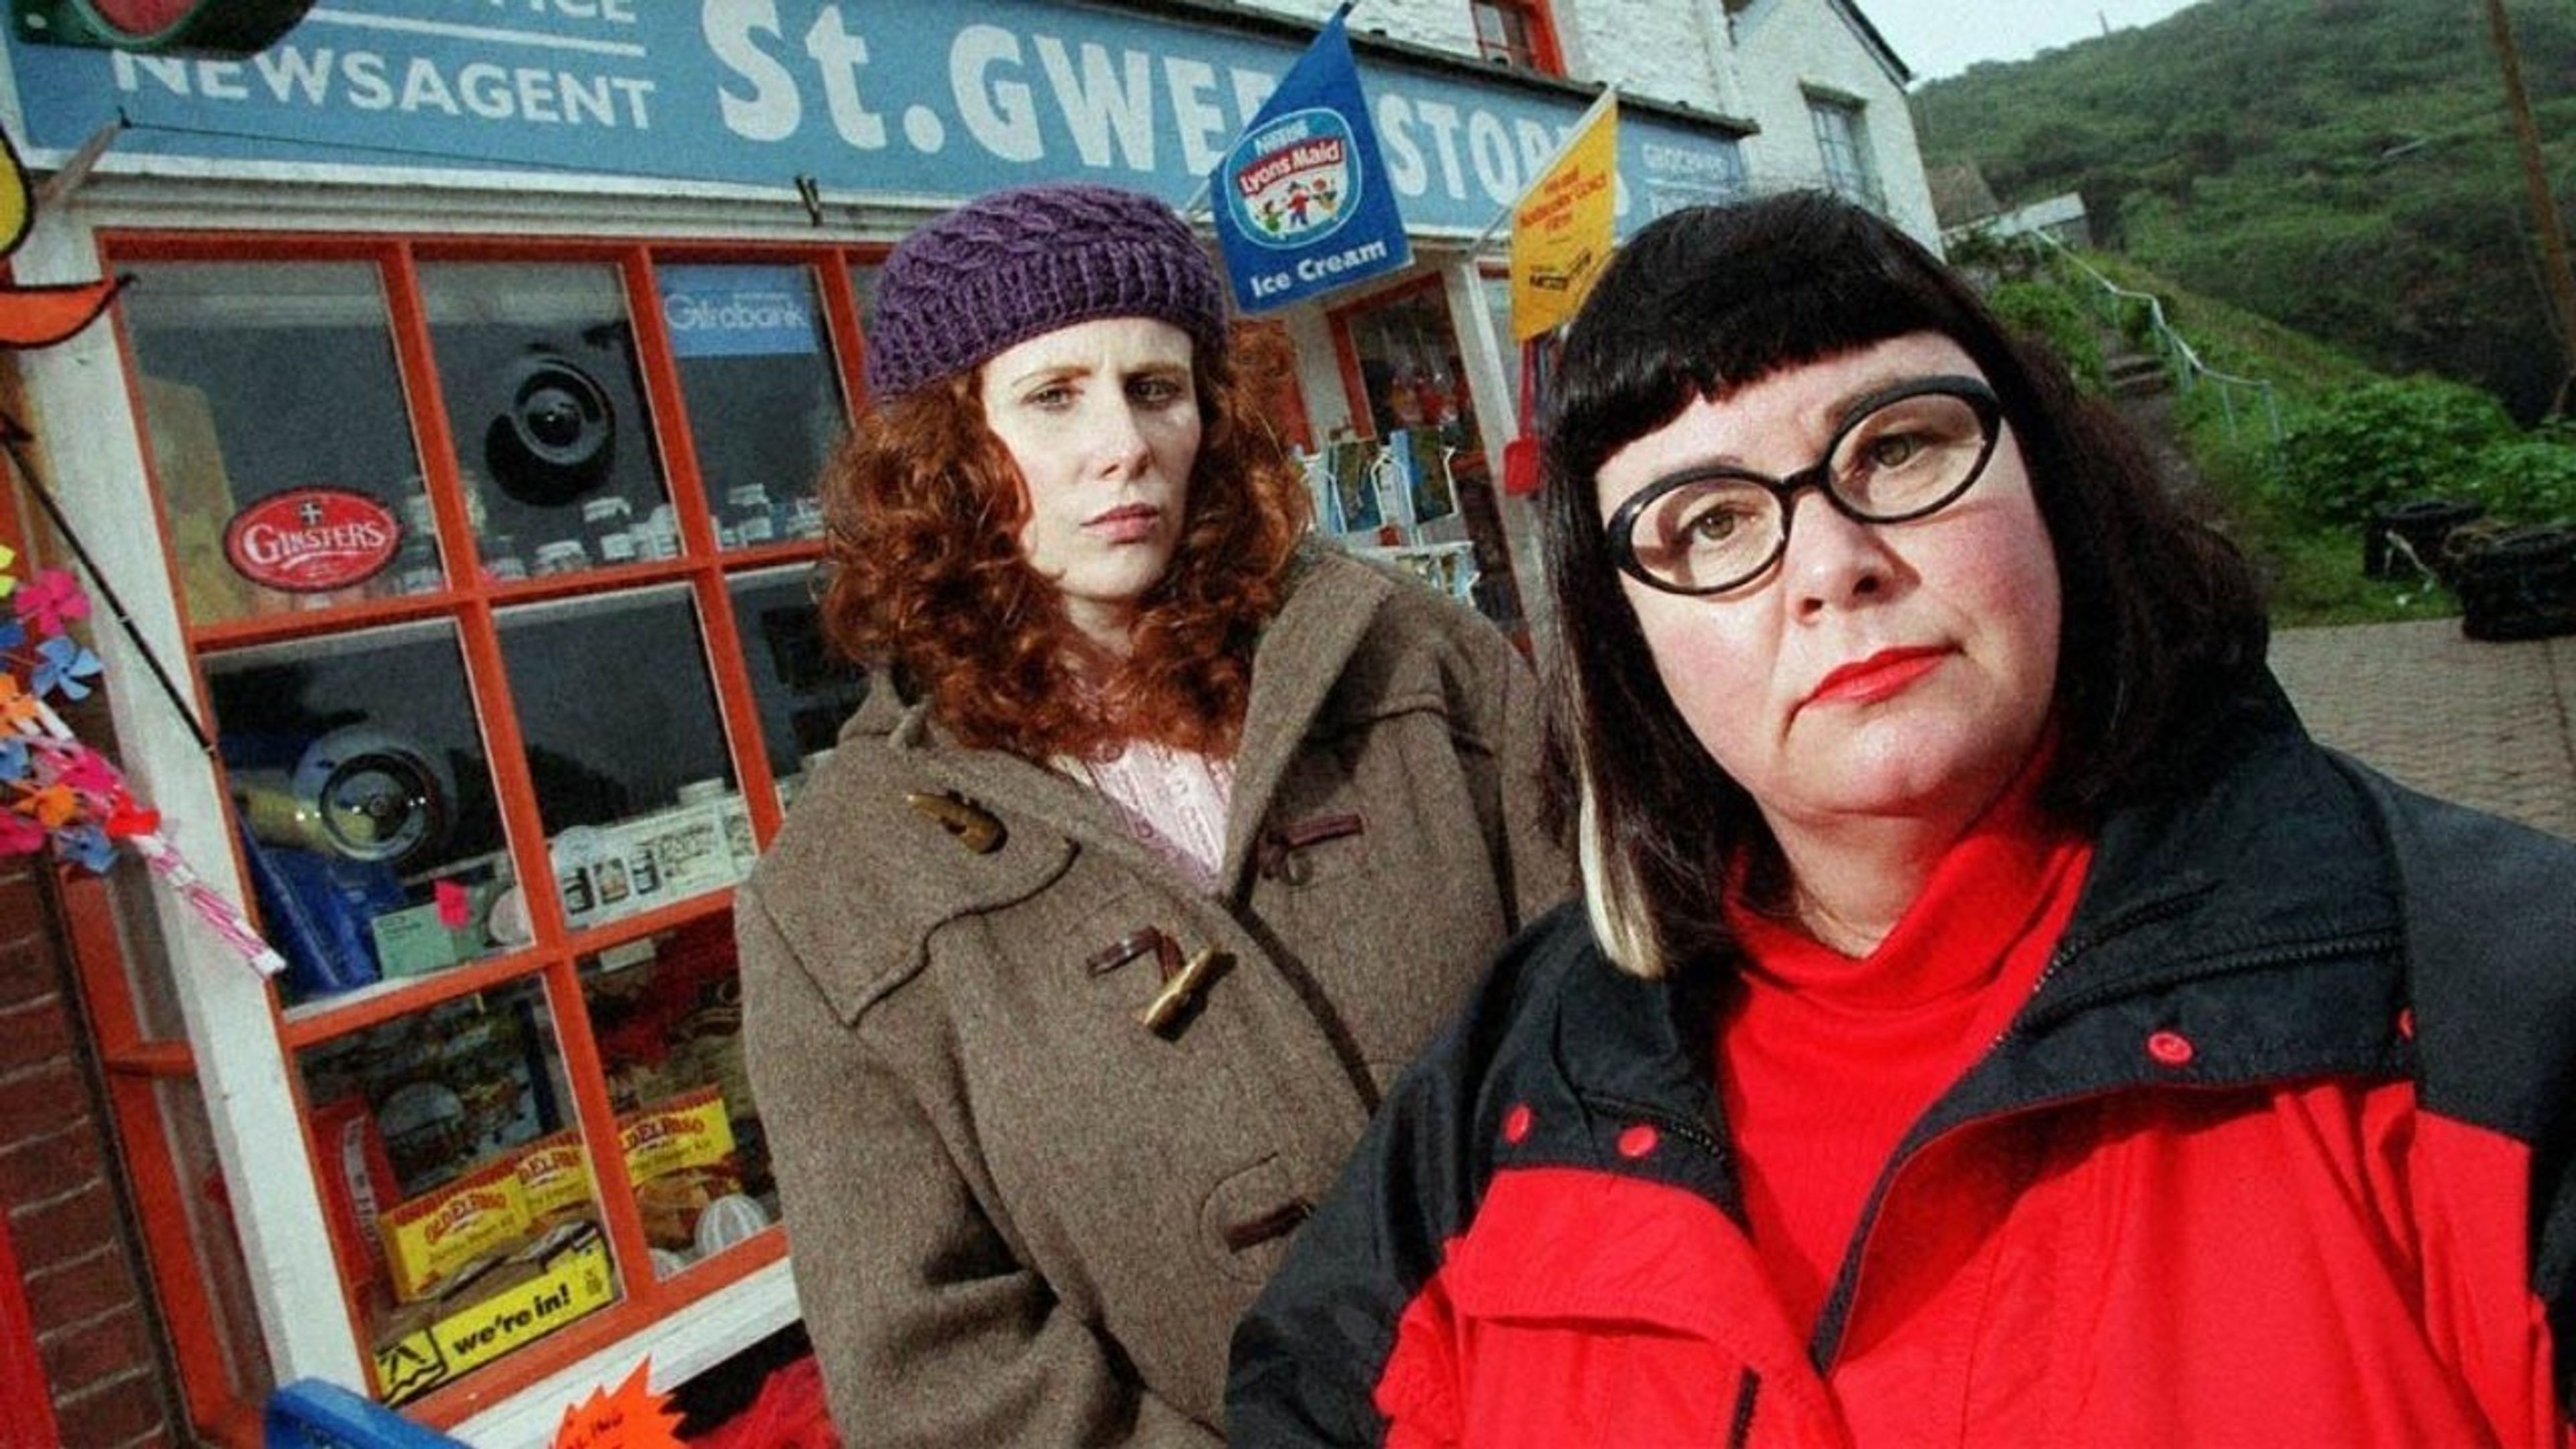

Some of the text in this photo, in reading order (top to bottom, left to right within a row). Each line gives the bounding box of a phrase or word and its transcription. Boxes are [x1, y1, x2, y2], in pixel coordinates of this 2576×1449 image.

[111, 45, 655, 129] NEWSAGENT
[1240, 139, 1340, 195] Lyons Maid
[1250, 240, 1387, 298] Ice Cream
[453, 1283, 572, 1355] we're in!
